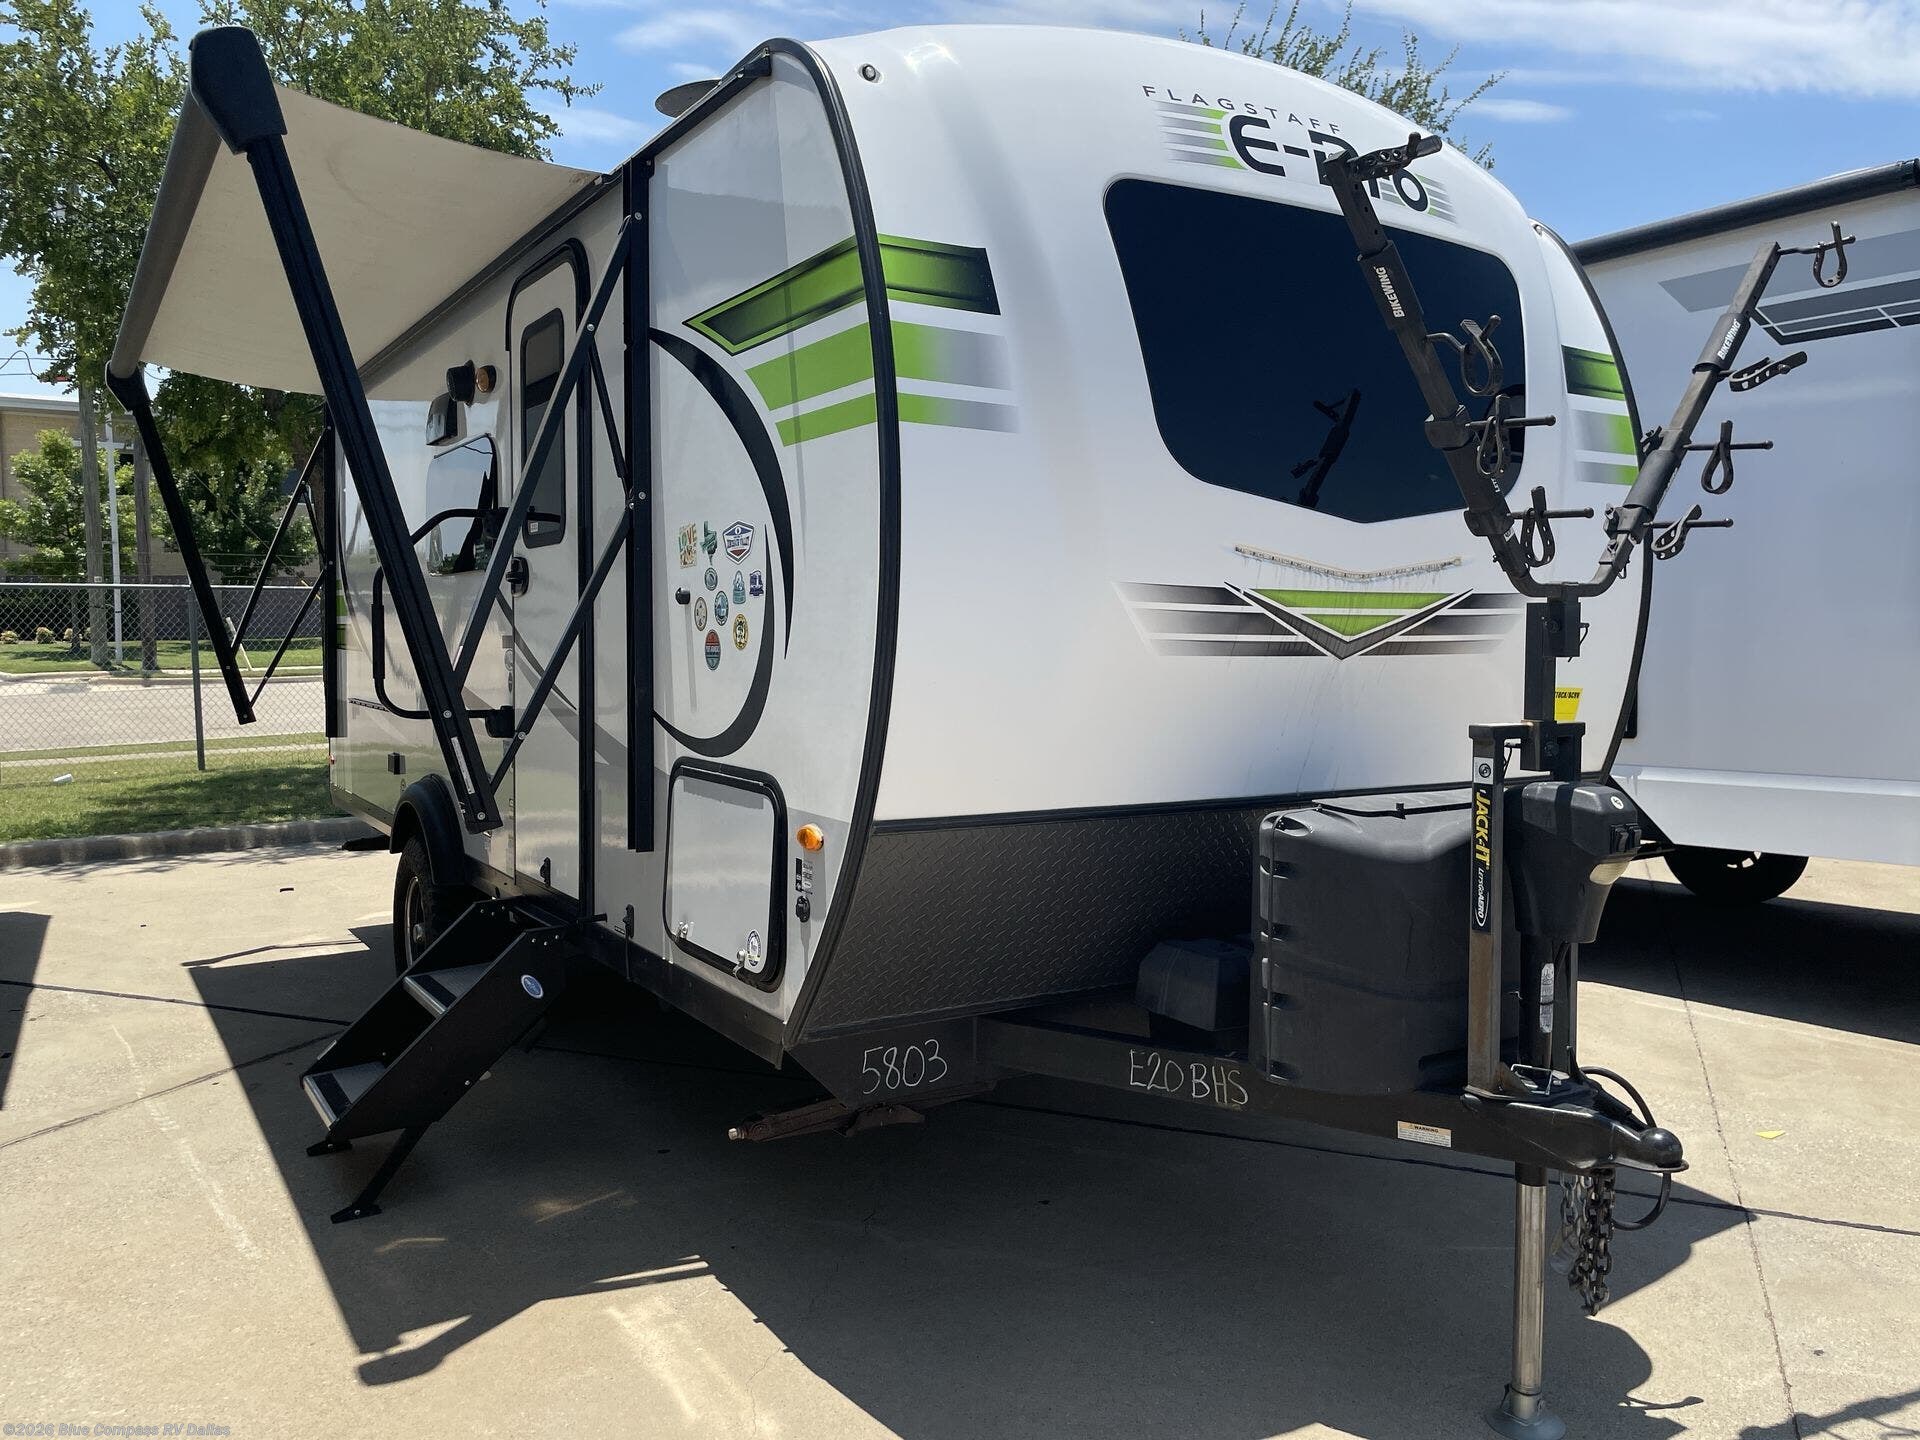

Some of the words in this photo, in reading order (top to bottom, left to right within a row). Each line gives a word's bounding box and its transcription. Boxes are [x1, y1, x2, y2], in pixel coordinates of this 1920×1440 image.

[1142, 85, 1340, 134] FLAGSTAFF
[1375, 266, 1405, 318] BIKEWING
[1475, 791, 1491, 867] JACK-IT
[862, 1038, 947, 1095] 5803
[1414, 1125, 1439, 1133] WARNING
